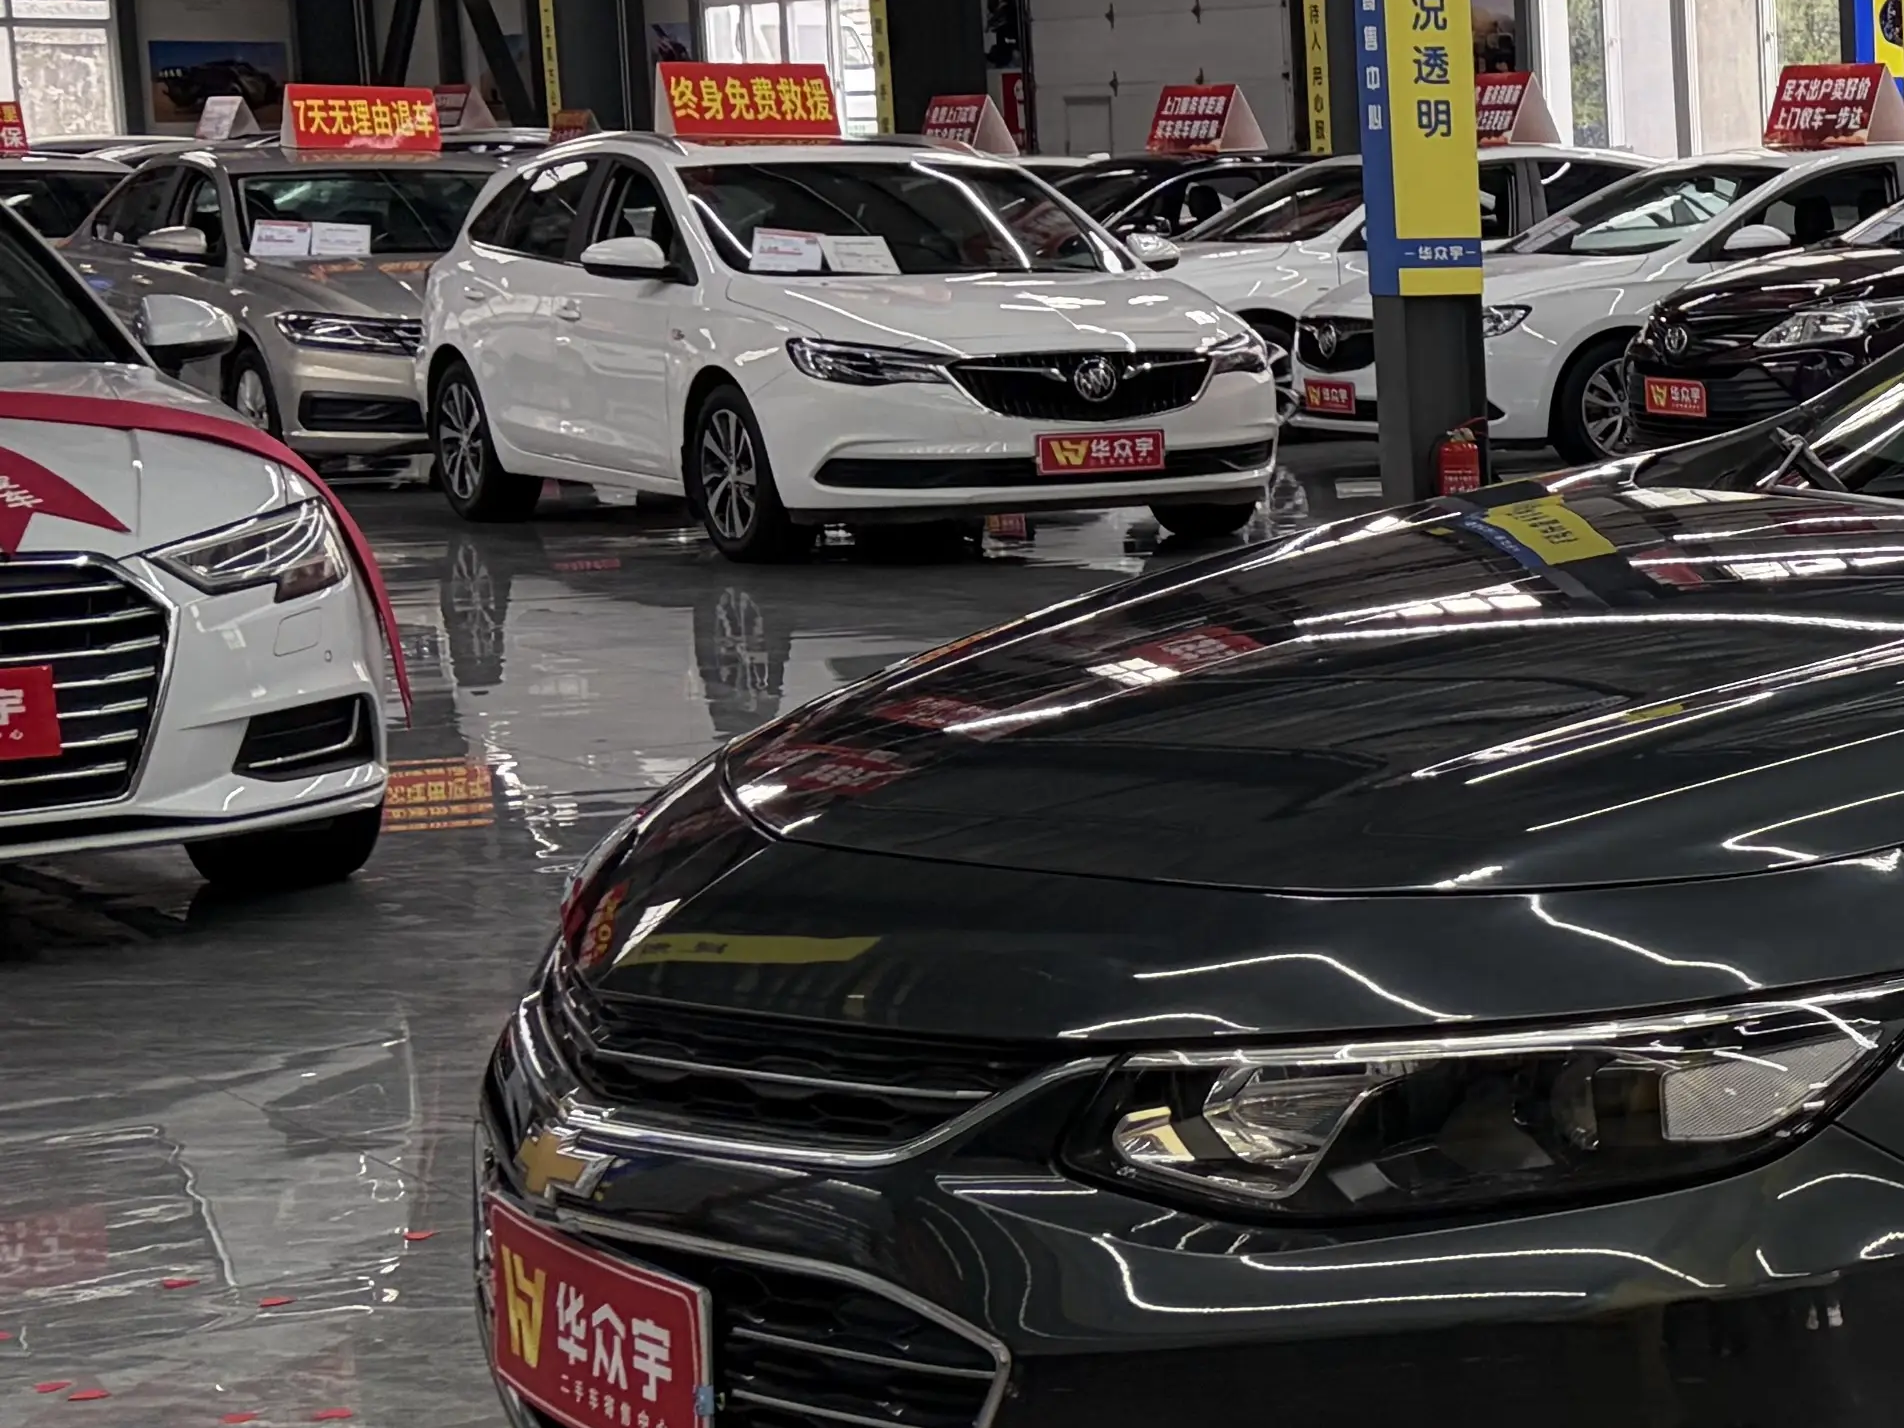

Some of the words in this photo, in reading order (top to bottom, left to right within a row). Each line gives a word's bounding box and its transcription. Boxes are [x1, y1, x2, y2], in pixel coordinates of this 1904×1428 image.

[670, 76, 833, 121] 终身免费救援
[1781, 77, 1871, 101] 足不出户卖好价
[292, 98, 436, 138] 7天无理由退车
[1090, 437, 1154, 460] 华众宇
[556, 1281, 672, 1402] 华众宇
